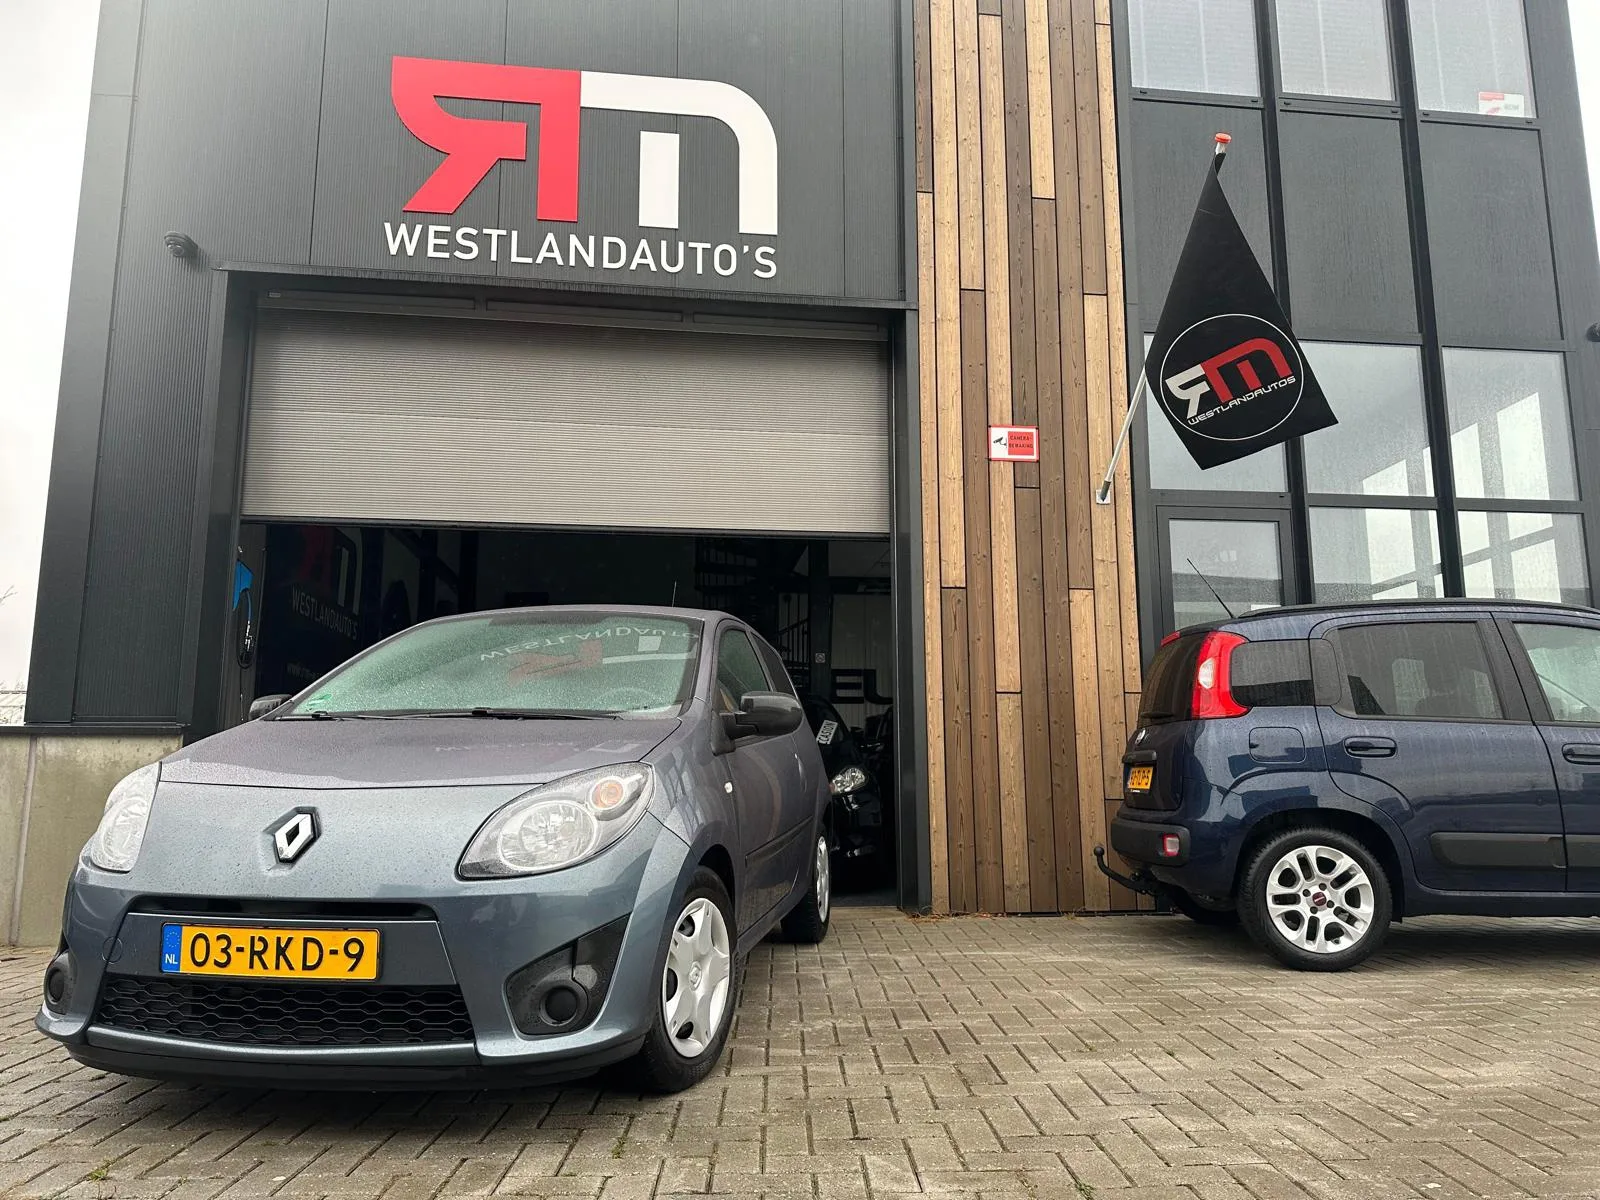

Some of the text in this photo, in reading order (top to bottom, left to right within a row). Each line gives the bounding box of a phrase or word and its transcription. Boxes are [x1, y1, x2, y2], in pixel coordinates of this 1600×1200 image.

[383, 221, 778, 279] WESTLANDAUTO'S
[1186, 375, 1297, 426] WESTLANDAUTOS
[165, 953, 179, 965] NL
[189, 932, 365, 972] 03-RKD-9
